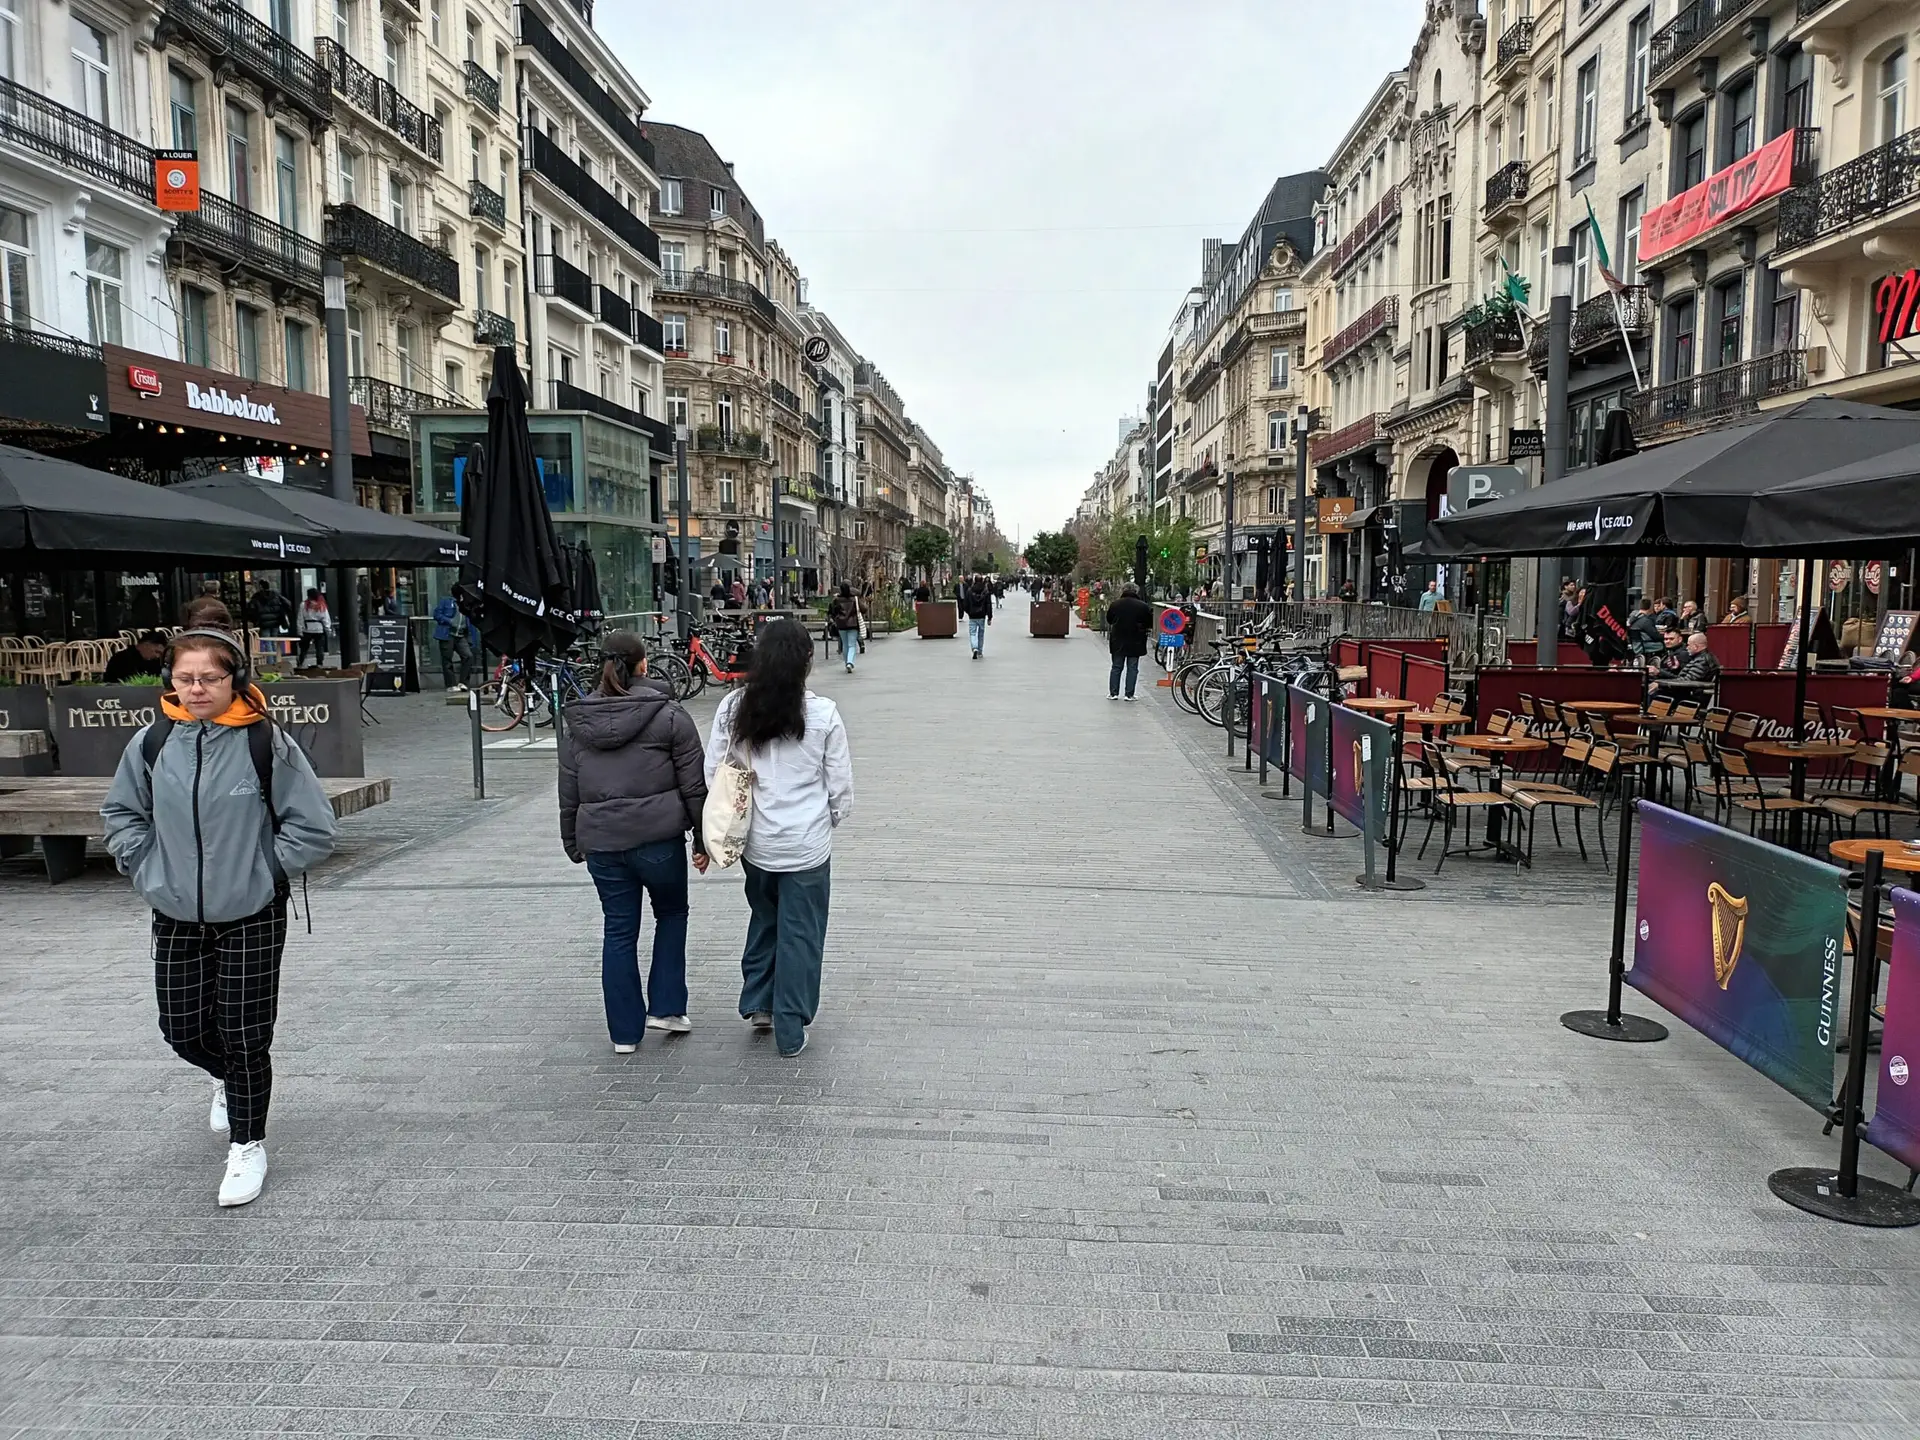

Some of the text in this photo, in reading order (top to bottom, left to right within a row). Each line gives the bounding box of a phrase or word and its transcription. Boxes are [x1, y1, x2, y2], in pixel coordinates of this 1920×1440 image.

[809, 341, 826, 356] AB
[185, 381, 281, 426] Babbelzot.
[1468, 474, 1492, 498] P
[1320, 515, 1349, 523] CAPITA
[1567, 521, 1576, 531] We
[1576, 520, 1593, 531] serve
[1601, 517, 1614, 529] ICE
[251, 539, 311, 554] We serve ICE COLD
[502, 582, 513, 595] We
[512, 591, 537, 607] serve
[550, 607, 565, 619] ICE
[97, 699, 122, 710] CAFE
[270, 695, 296, 706] CAFE
[268, 704, 330, 724] TTEKO
[1817, 937, 1837, 1046] GUINNESS
